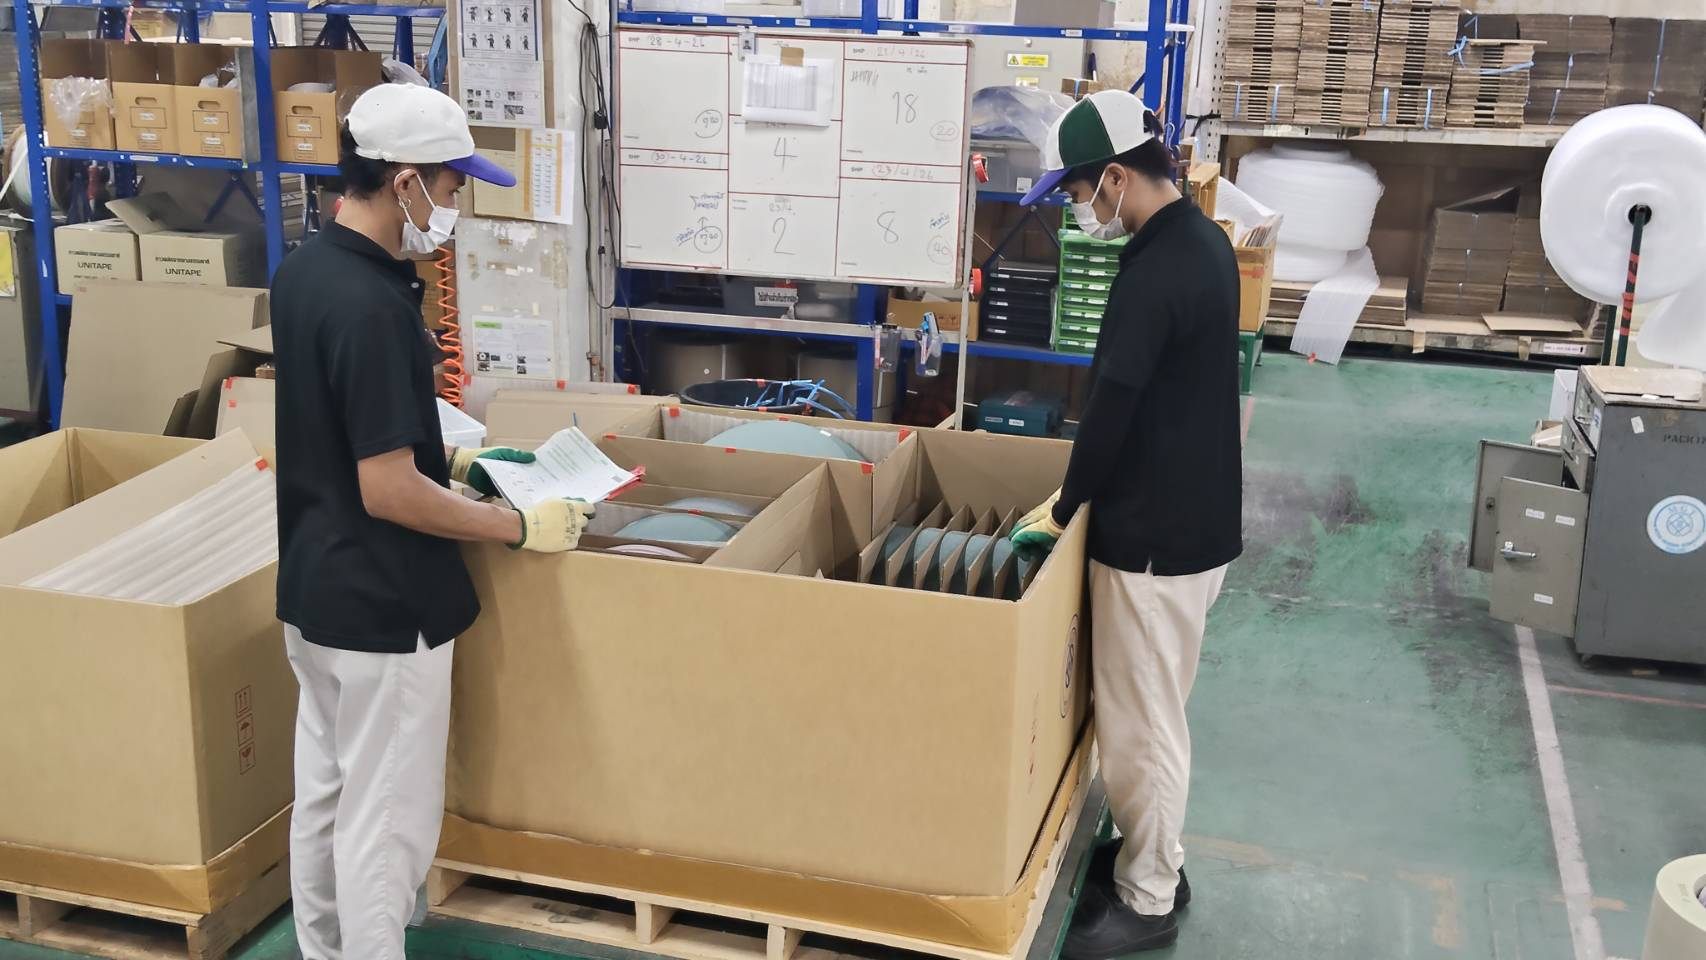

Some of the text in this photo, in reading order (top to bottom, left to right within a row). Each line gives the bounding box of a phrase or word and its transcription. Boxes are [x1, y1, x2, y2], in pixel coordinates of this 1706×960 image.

[892, 91, 919, 125] 18
[773, 137, 799, 172] 4
[772, 217, 797, 256] 2
[876, 210, 900, 244] 8
[77, 261, 113, 271] UNITAPE
[165, 267, 203, 277] UNITAPE
